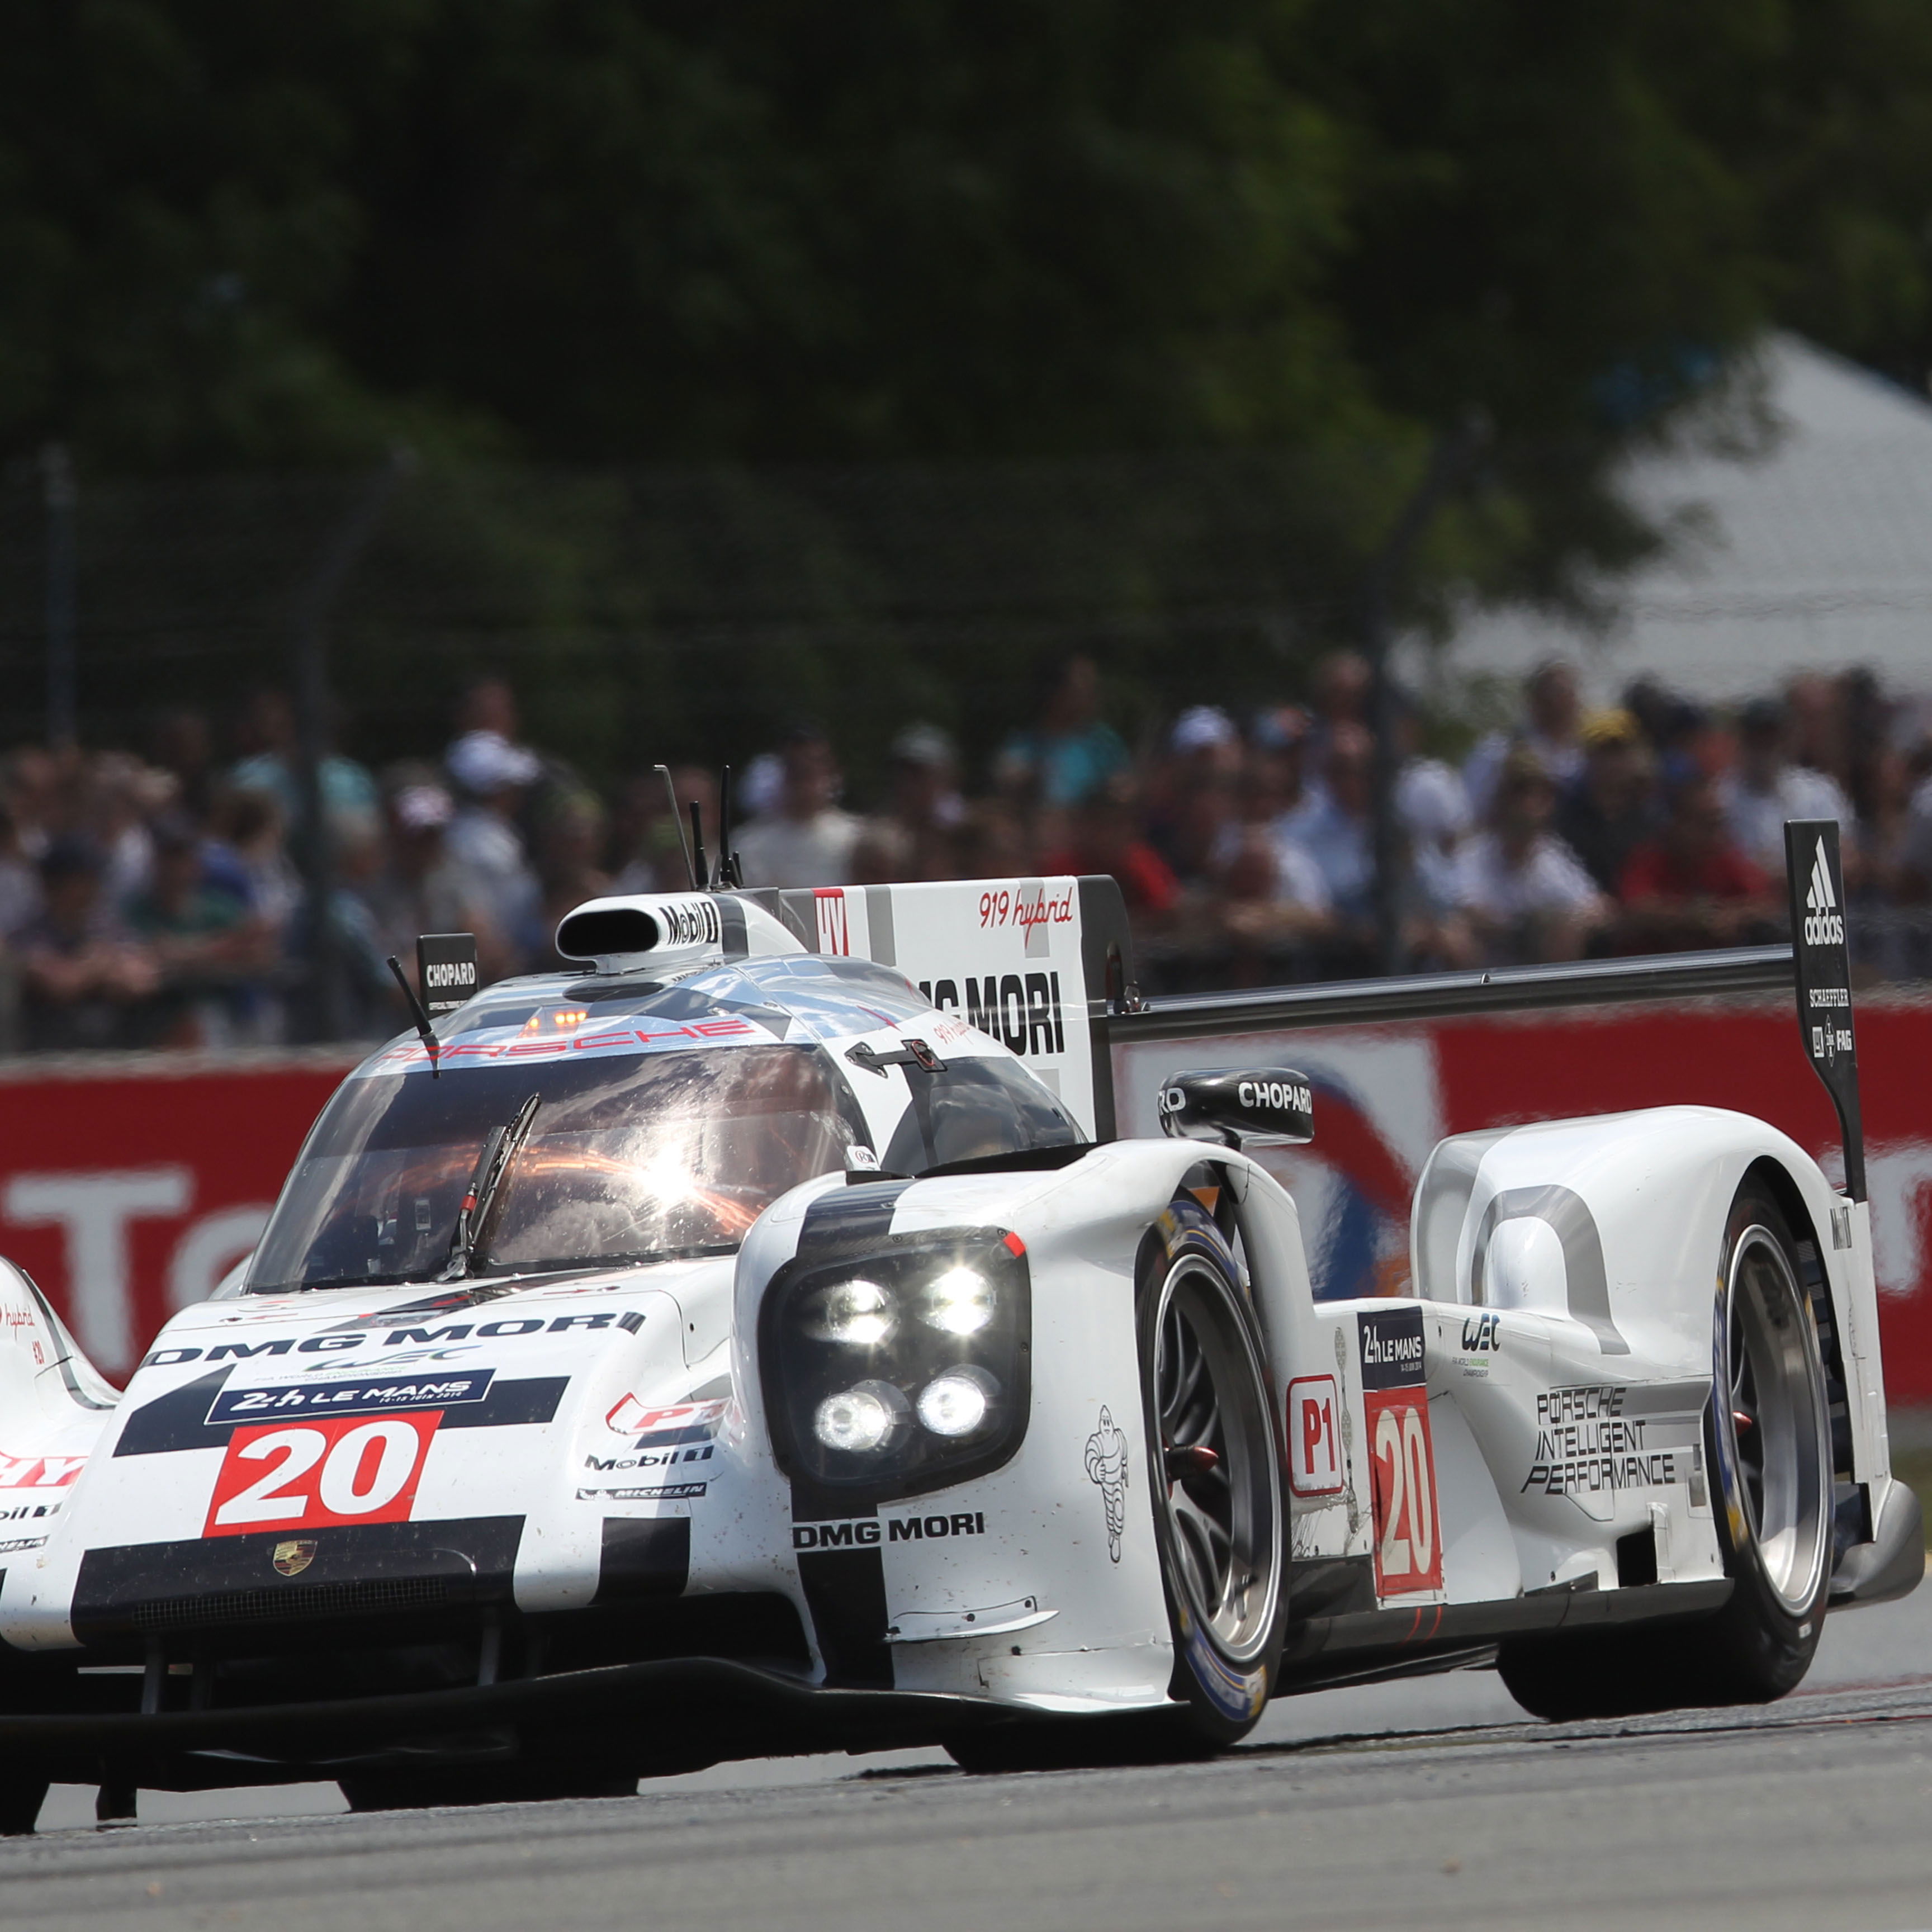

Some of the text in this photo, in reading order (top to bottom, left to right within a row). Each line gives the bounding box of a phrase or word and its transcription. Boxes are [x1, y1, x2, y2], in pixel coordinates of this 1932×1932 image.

[657, 902, 705, 945] Mobil
[979, 886, 1073, 950] 919 hybrid
[1805, 908, 1844, 945] adidas
[427, 962, 475, 987] CHOPARD
[965, 971, 1065, 1056] MORI
[1809, 988, 1849, 1007] SCHAEFFLER
[378, 1020, 755, 1062] PORSCHE
[1836, 1030, 1853, 1051] FAG
[1238, 1082, 1313, 1115] CHOPARD
[140, 1311, 647, 1368] DMG MORI
[1382, 1339, 1394, 1363] LE
[1395, 1336, 1422, 1361] MANS
[1462, 1313, 1501, 1352] WEC
[310, 1390, 360, 1404] LE
[361, 1380, 472, 1399] MANS
[1536, 1387, 1627, 1426] PORSCHE
[1302, 1398, 1336, 1475] P1
[1535, 1419, 1646, 1461] INTELLIGENT
[215, 1420, 420, 1526] 20
[584, 1451, 680, 1471] Mobil
[1519, 1453, 1676, 1494] PERFORMANCE
[615, 1485, 705, 1498] MICHELIN
[1376, 1407, 1432, 1576] 20
[792, 1512, 984, 1549] DMG MORI
